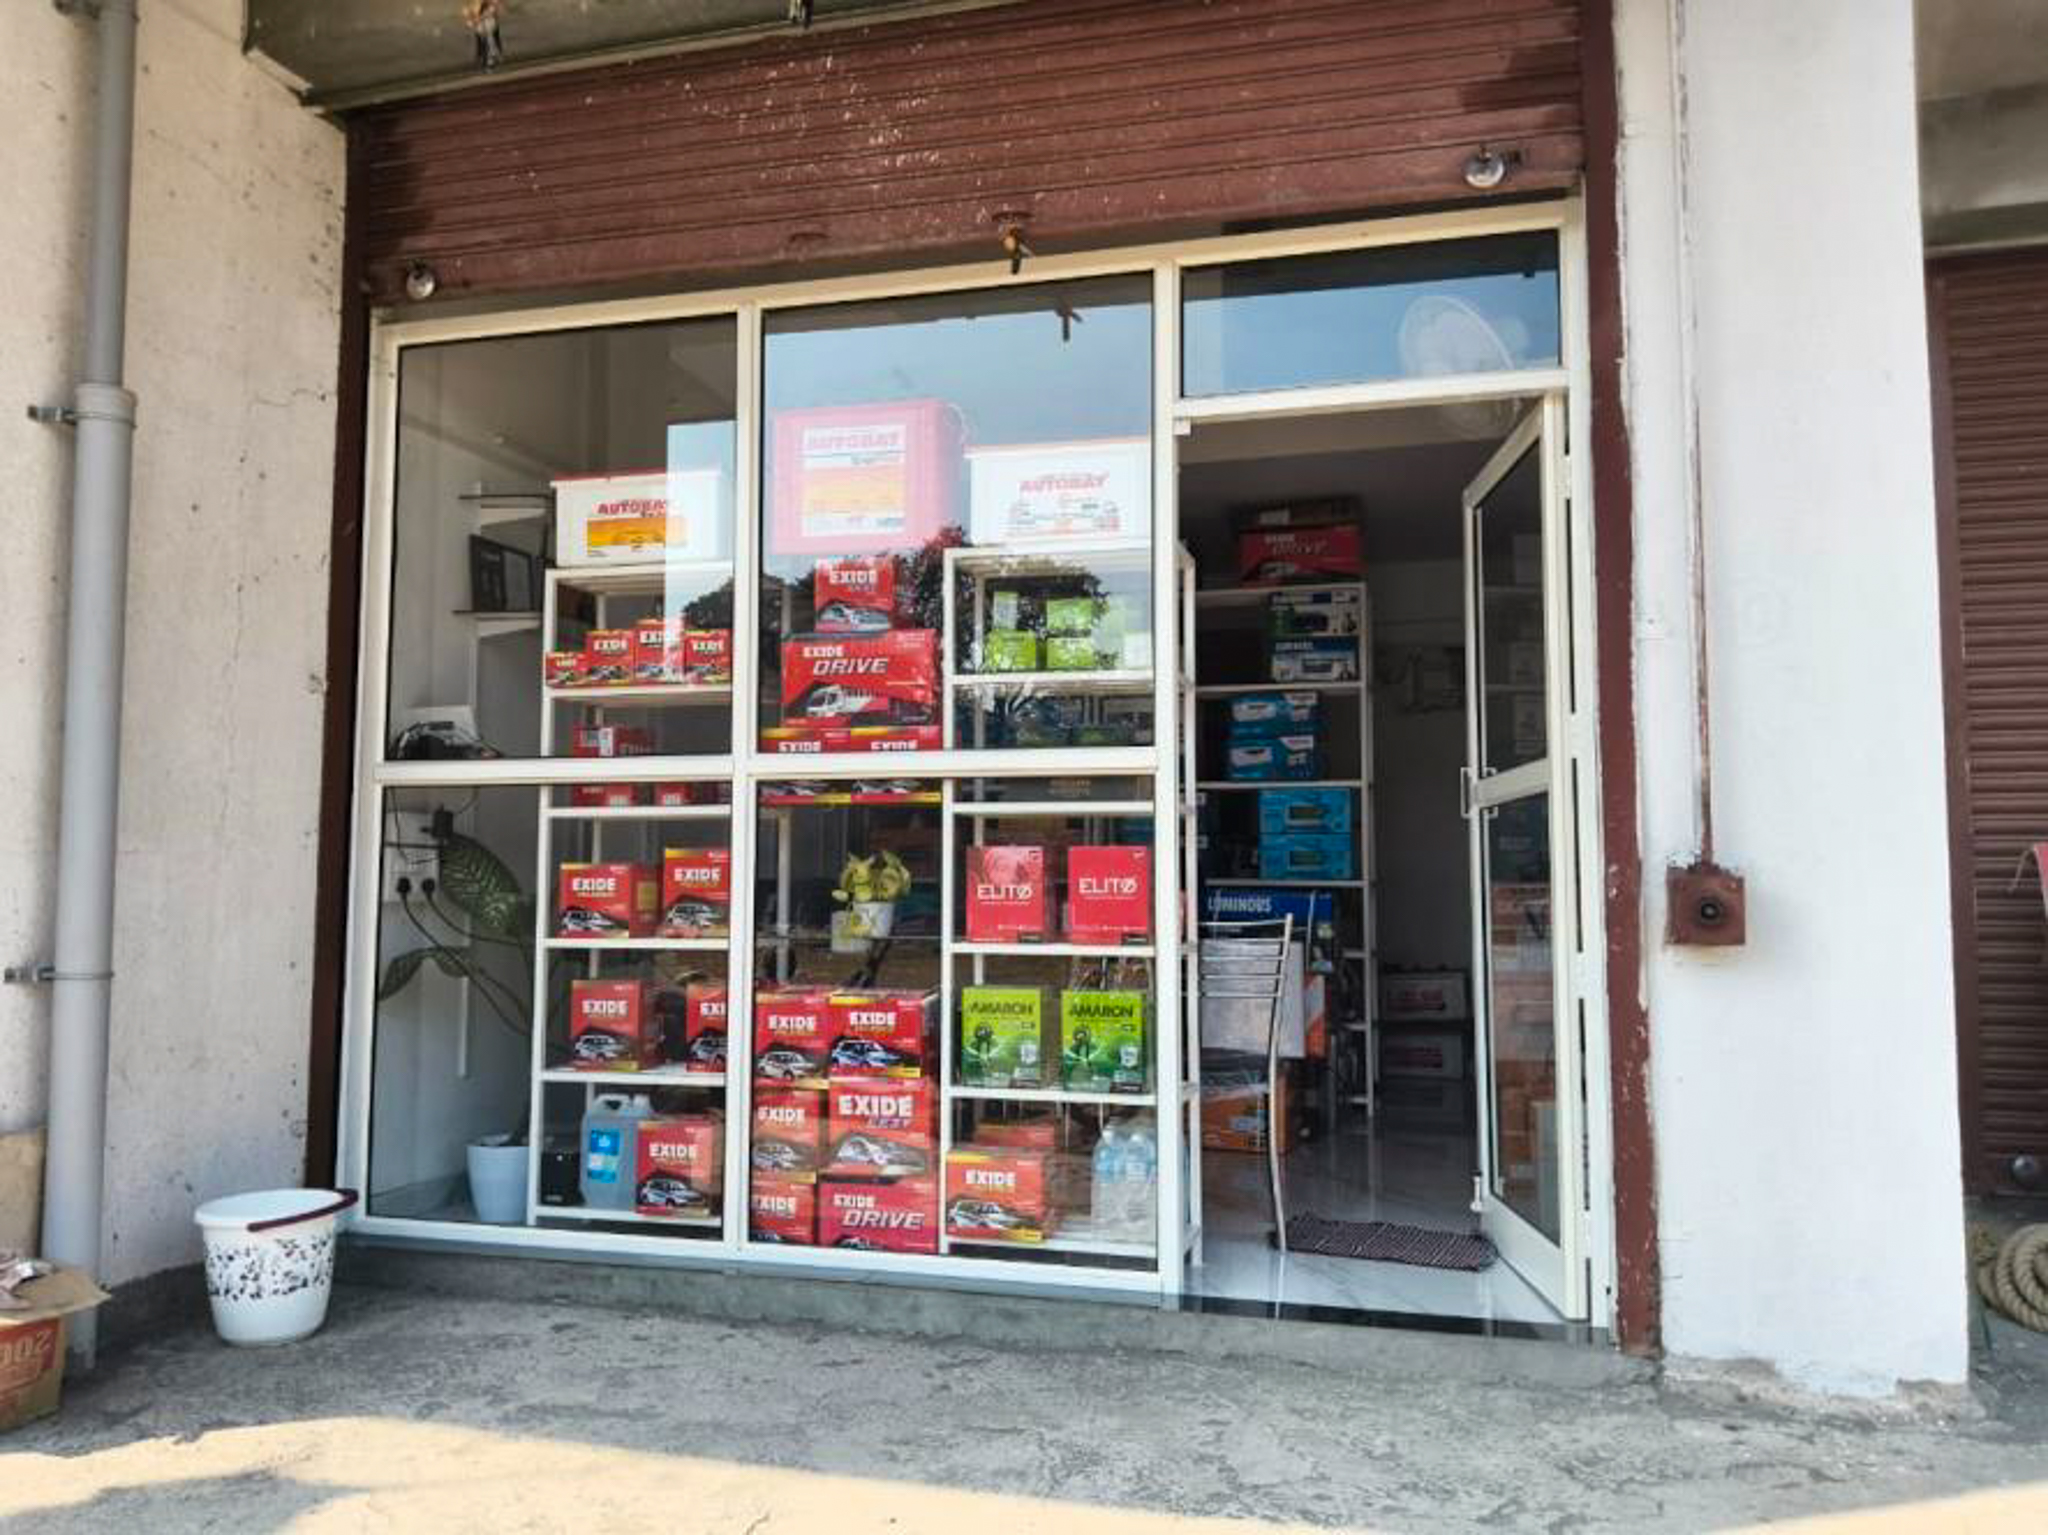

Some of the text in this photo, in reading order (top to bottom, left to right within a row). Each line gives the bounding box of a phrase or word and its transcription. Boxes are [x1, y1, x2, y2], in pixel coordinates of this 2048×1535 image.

[829, 569, 878, 585] EXIDE
[803, 645, 845, 658] EXIDE
[812, 657, 888, 675] DRIVE
[673, 867, 721, 882] EXIDE
[572, 877, 617, 892] EXIDE
[1208, 896, 1273, 913] LUMINOUS
[582, 999, 628, 1015] EXIDE
[701, 1001, 726, 1017] EXI
[1070, 1004, 1134, 1019] AMARON
[767, 1014, 817, 1032] EXIDE
[849, 1011, 897, 1027] EXIDE
[838, 1095, 913, 1117] EXIDE
[758, 1106, 805, 1124] EXIDE
[649, 1143, 699, 1158] EXIDE
[965, 1169, 1017, 1186] EXIDE
[833, 1193, 876, 1208] EXIDE
[842, 1210, 927, 1230] DRIVE
